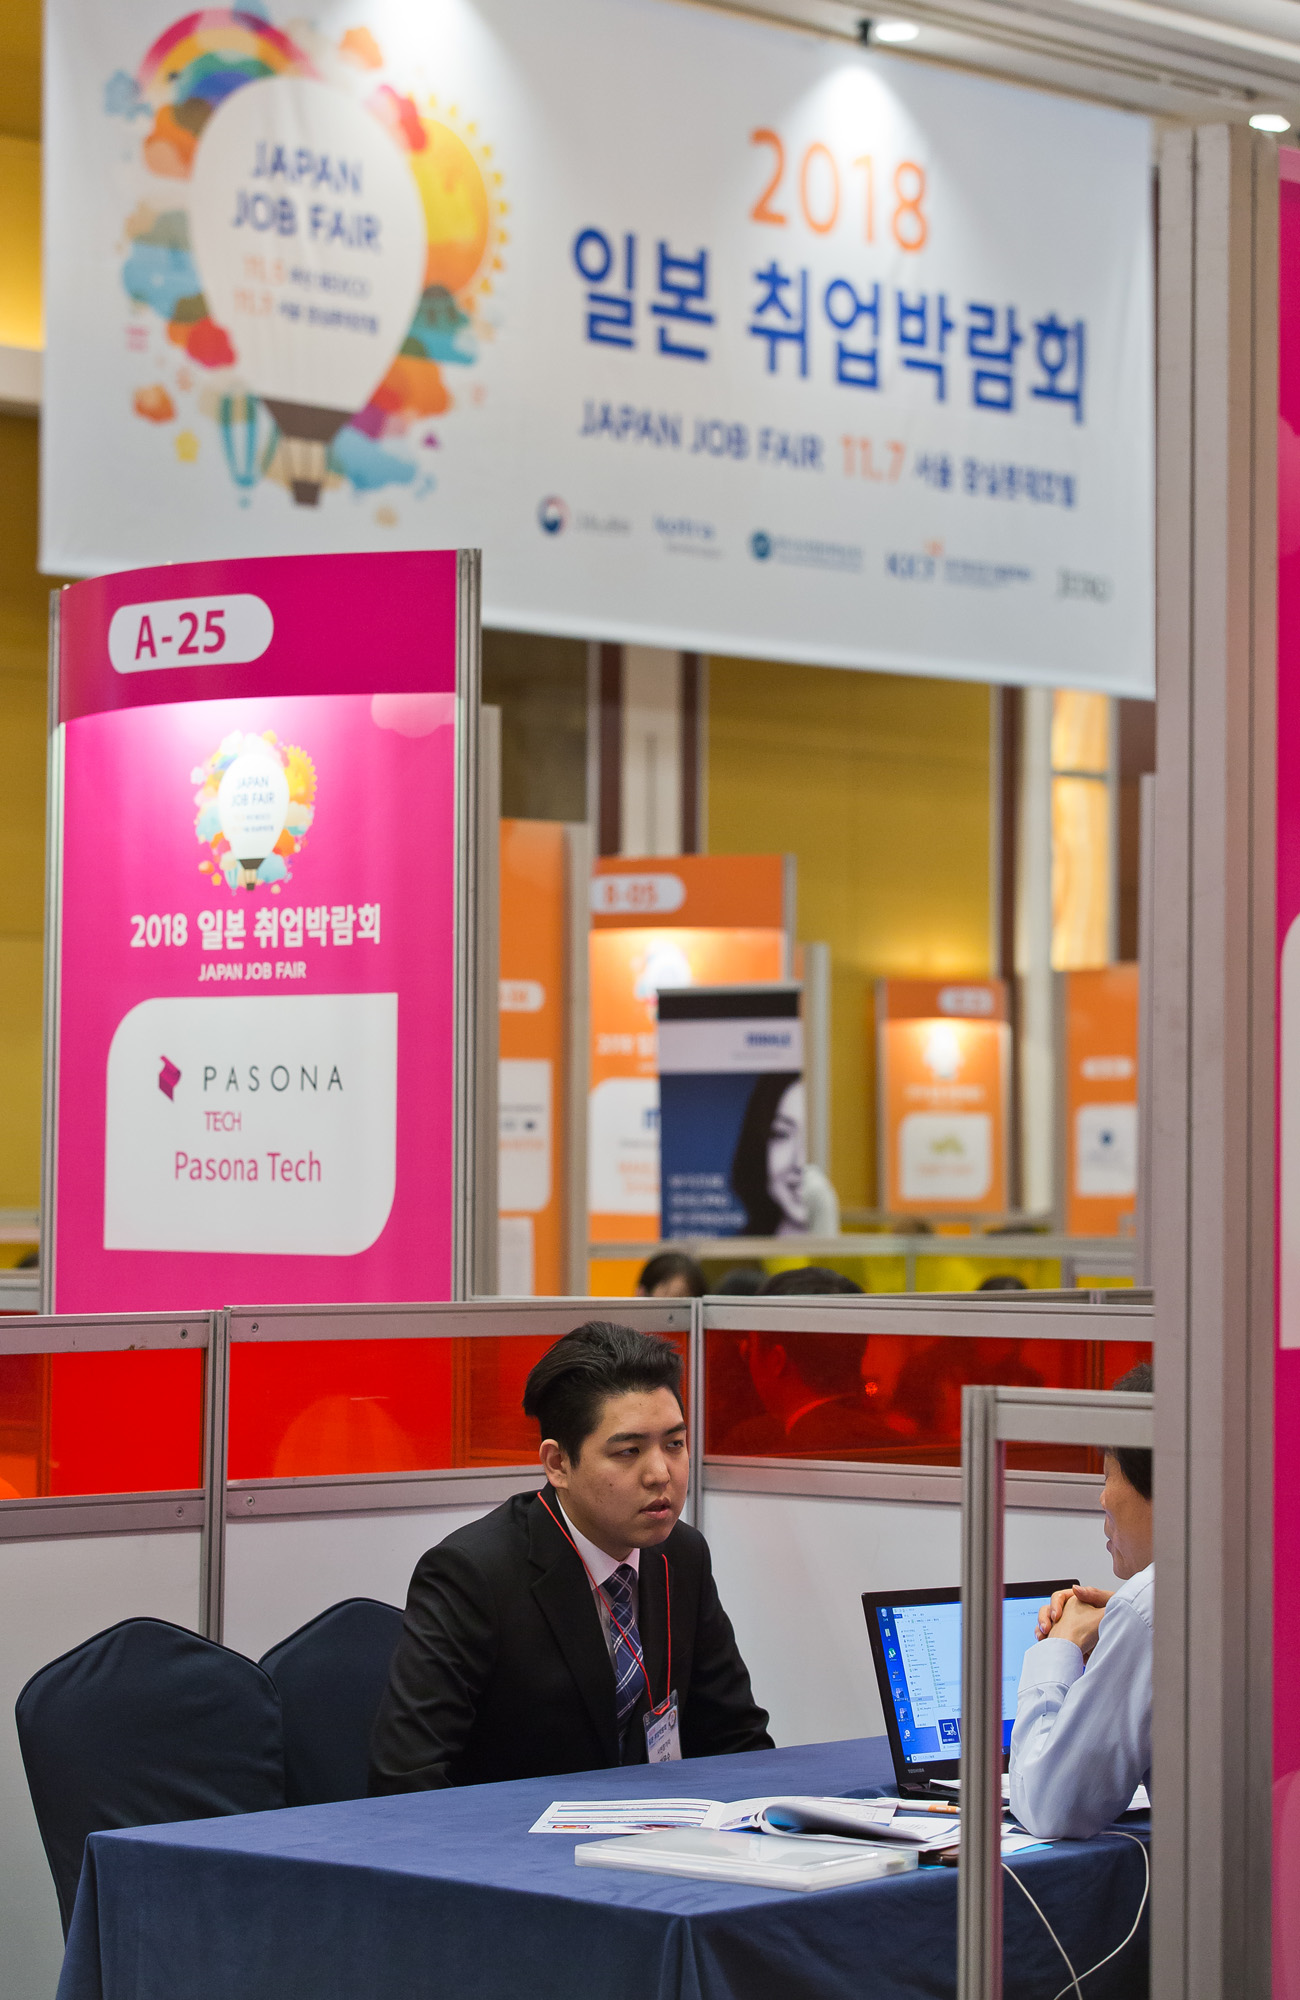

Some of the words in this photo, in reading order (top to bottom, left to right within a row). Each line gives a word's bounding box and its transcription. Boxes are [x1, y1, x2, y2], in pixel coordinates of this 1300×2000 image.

[253, 141, 363, 196] JAPAN
[749, 126, 930, 253] 2018
[233, 188, 297, 236] JOB
[310, 203, 381, 254] FAIR
[572, 227, 716, 364] 일본
[748, 260, 1088, 426] 취업박람회
[578, 397, 683, 447] JAPAN
[688, 415, 748, 462] JOB
[757, 426, 825, 473] FAIR
[841, 434, 906, 484] 11.7
[135, 610, 226, 660] A-25
[231, 794, 249, 807] JOB
[252, 792, 275, 804] FAIR
[237, 776, 269, 789] JAPAN
[130, 912, 188, 948] 2018
[197, 908, 246, 950] 일본
[253, 903, 380, 949] 취업박람회
[197, 963, 243, 982] JAPAN
[244, 962, 272, 980] JOB
[275, 961, 307, 979] FAIR
[204, 1065, 343, 1092] PASONA
[204, 1111, 242, 1132] TECH
[174, 1151, 258, 1181] Pasona
[266, 1150, 321, 1182] Tech
